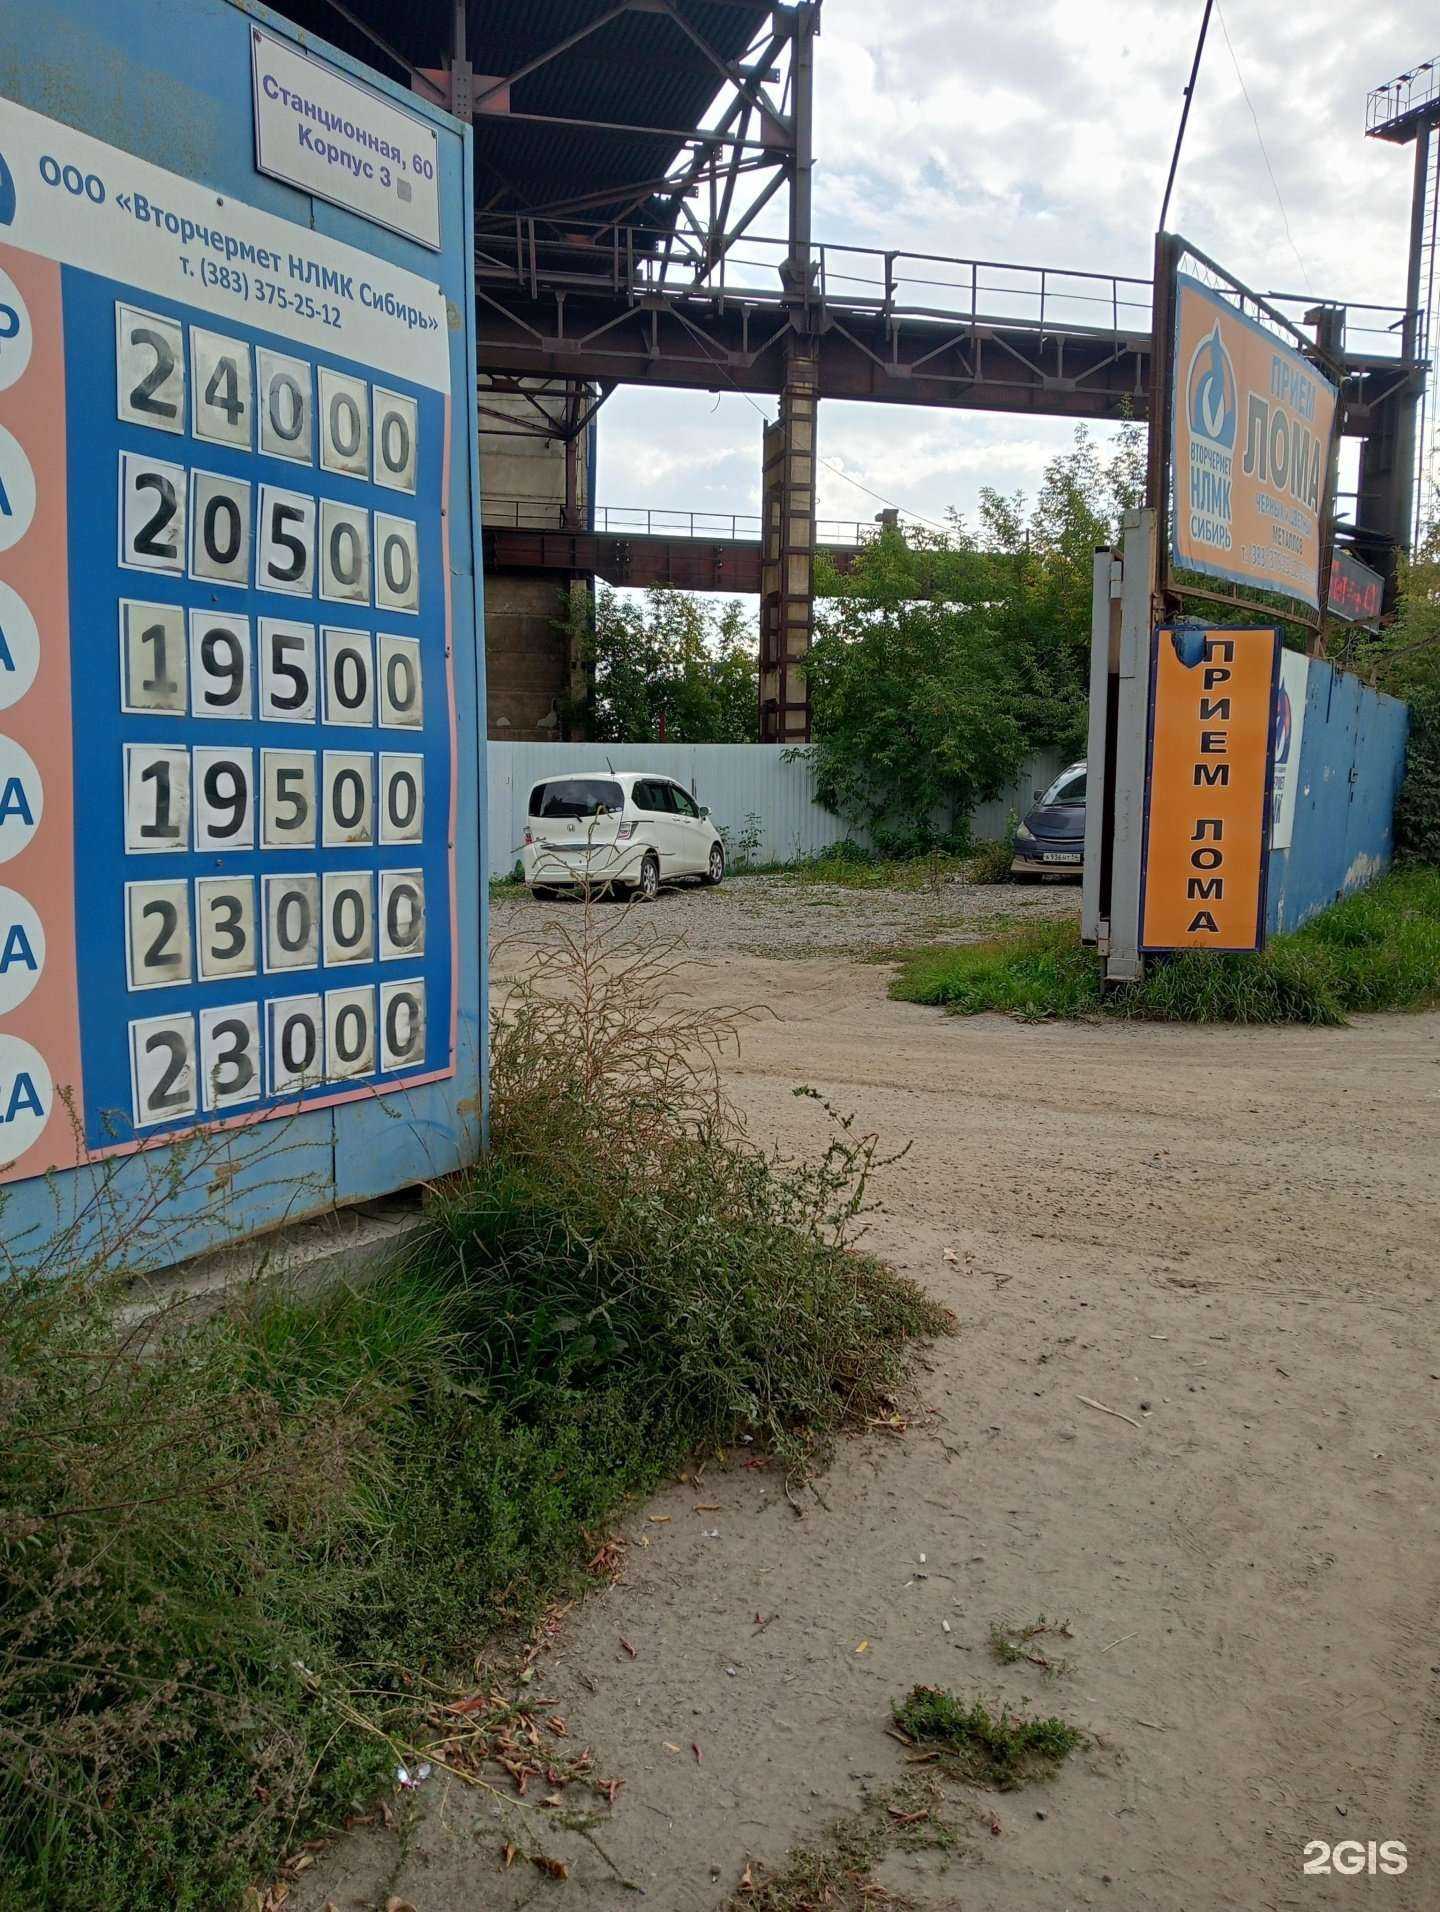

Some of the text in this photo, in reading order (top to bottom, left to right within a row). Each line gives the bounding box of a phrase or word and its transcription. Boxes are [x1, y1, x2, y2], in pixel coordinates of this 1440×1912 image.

[262, 74, 434, 181] Станционная, 60
[298, 123, 392, 188] Корпус 3
[39, 155, 439, 331] ООО «Вторчермет НЛМК Сибирь»
[179, 255, 342, 329] т. (383) 375-25-12
[130, 327, 410, 473] 24000
[1271, 354, 1318, 420] ПРИЕМ
[1189, 442, 1232, 477] ВТОРЧЕРМЕТ
[1190, 465, 1232, 522] НЛМК
[1243, 392, 1321, 517] ЛОМА
[133, 472, 412, 595] 20500
[1190, 515, 1232, 549] СИБИРЬ
[141, 623, 416, 713] 19500
[1193, 640, 1235, 786] ПРИЕМ
[140, 759, 417, 839] 19500
[1187, 819, 1224, 933] ЛОМА
[142, 883, 424, 968] 23000
[145, 991, 423, 1112] 23000
